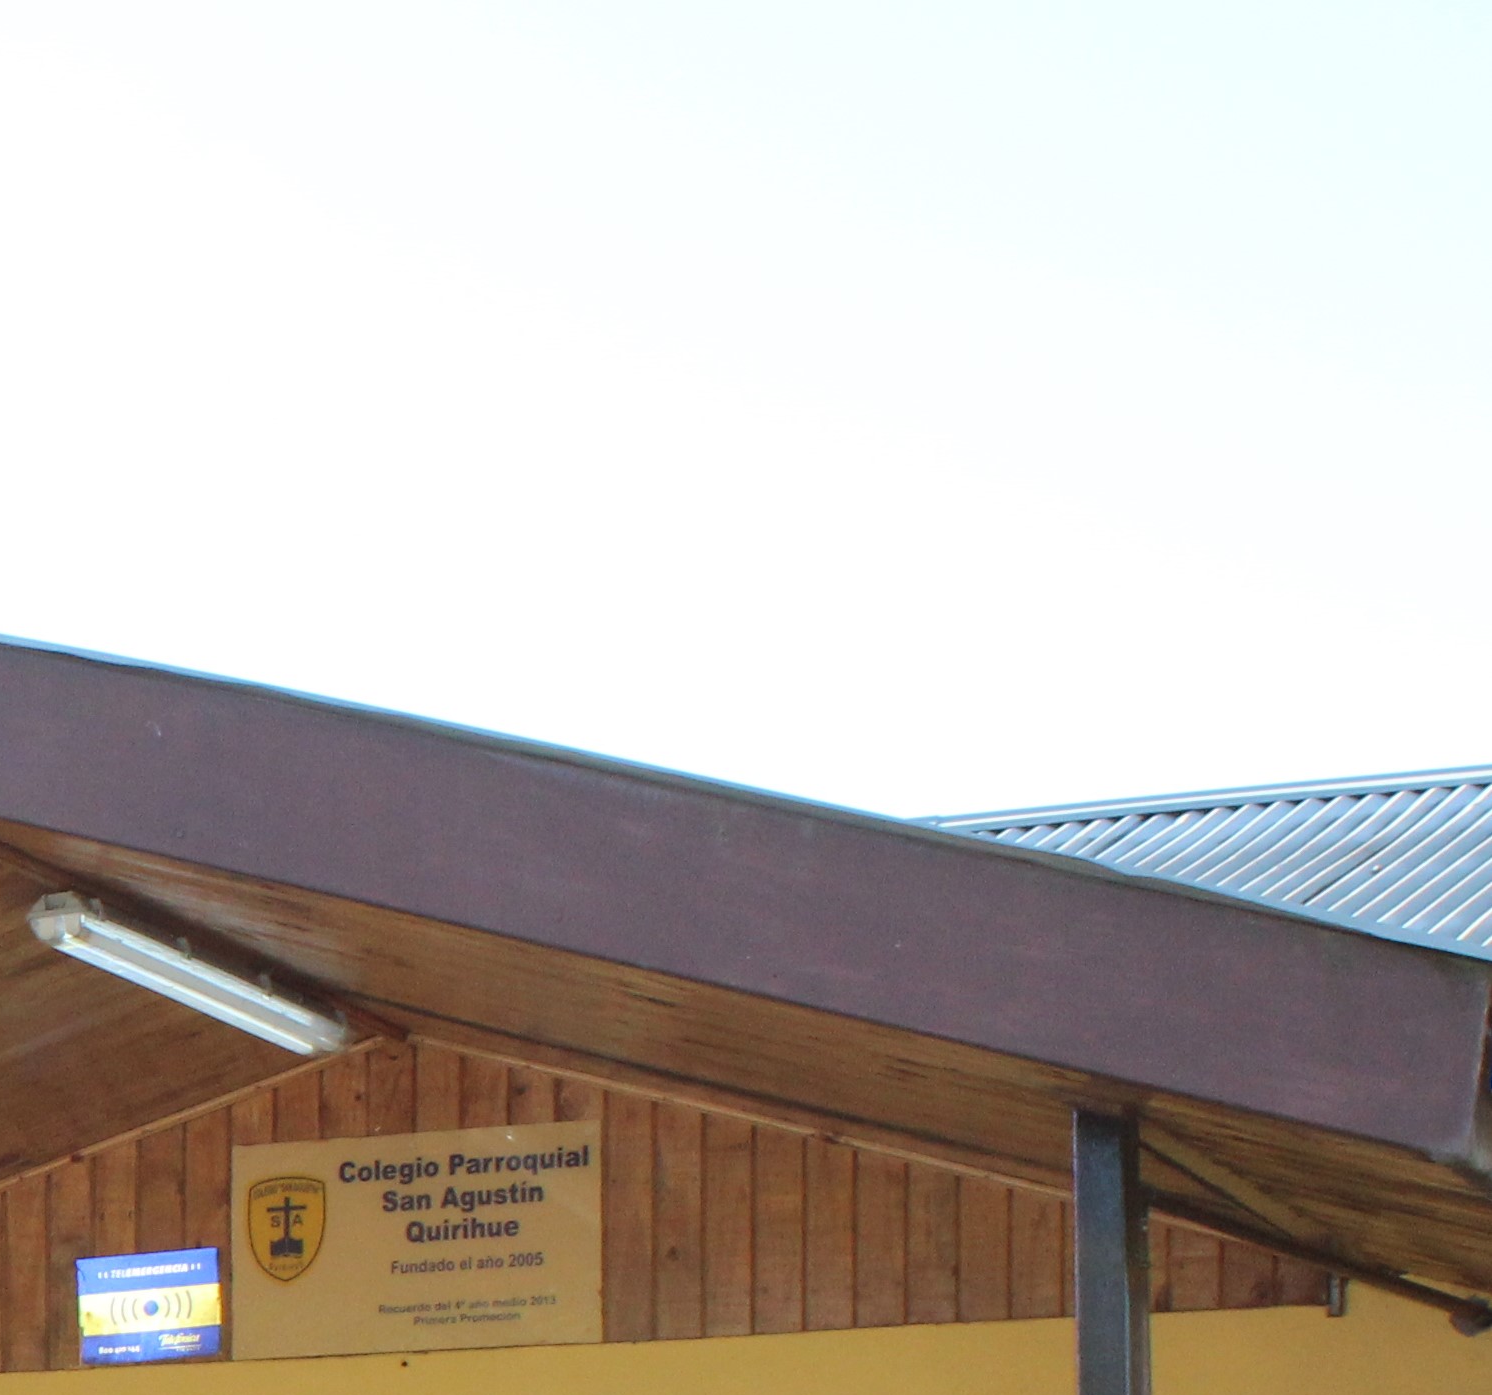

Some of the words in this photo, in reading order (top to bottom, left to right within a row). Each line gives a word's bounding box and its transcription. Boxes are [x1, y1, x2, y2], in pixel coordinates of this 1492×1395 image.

[338, 1157, 440, 1185] Colegio
[448, 1145, 590, 1176] Parroquial
[382, 1190, 432, 1213] San
[440, 1181, 545, 1213] Agustín
[405, 1217, 520, 1243] Quirihue
[391, 1257, 455, 1275] Fundado
[459, 1256, 472, 1271] el
[476, 1255, 504, 1270] año
[508, 1251, 545, 1268] 2005
